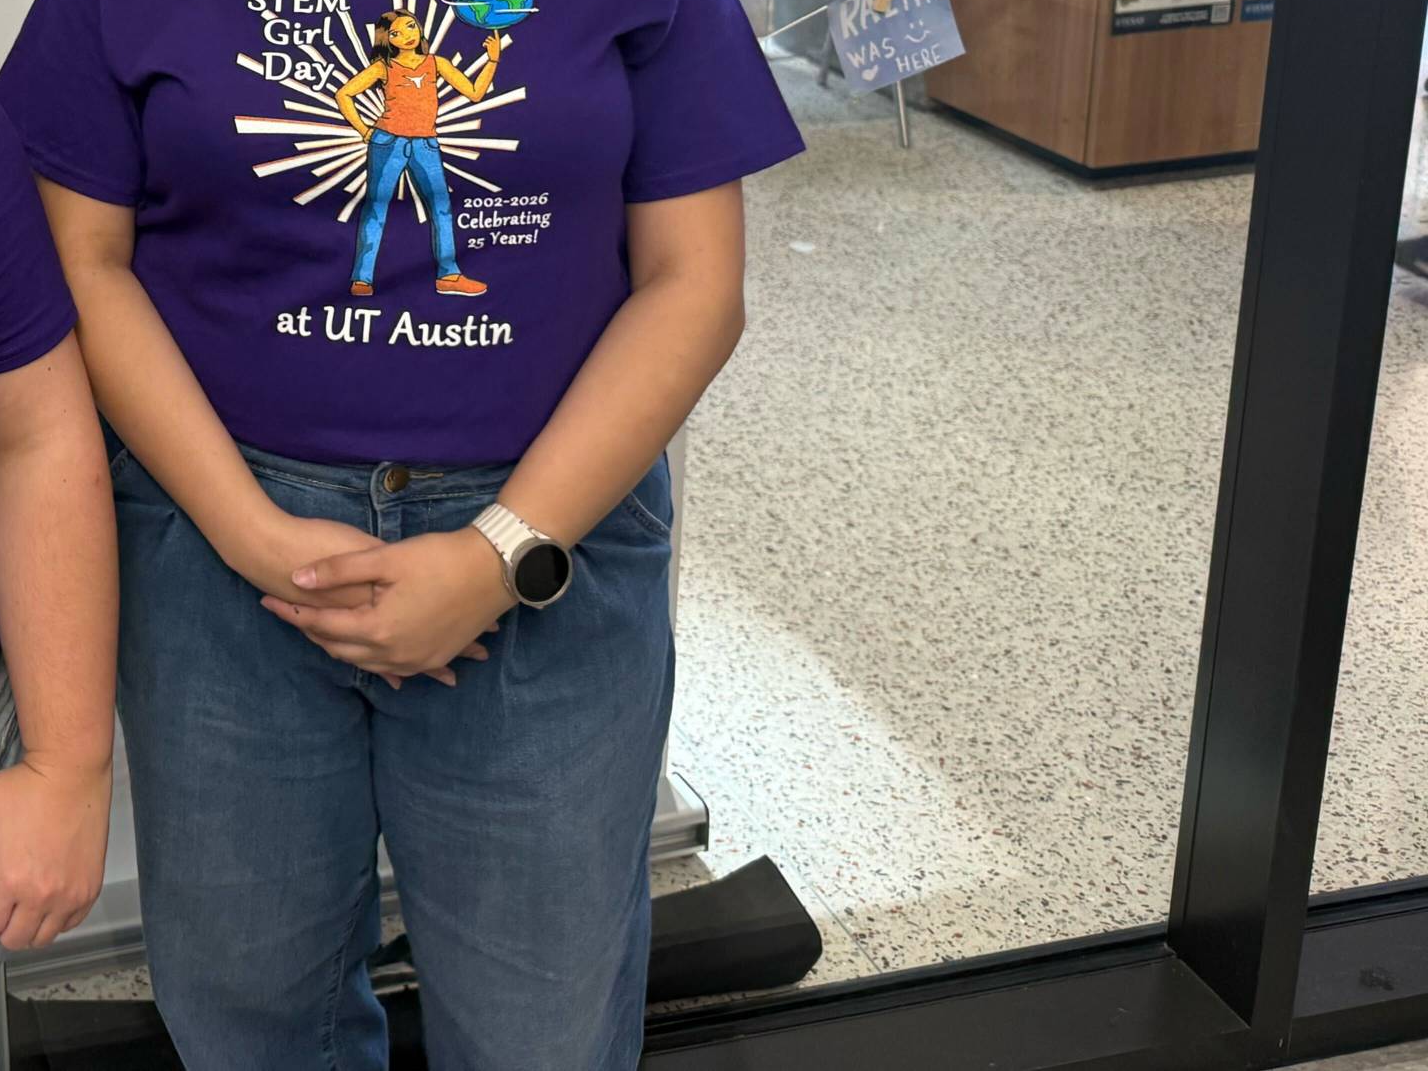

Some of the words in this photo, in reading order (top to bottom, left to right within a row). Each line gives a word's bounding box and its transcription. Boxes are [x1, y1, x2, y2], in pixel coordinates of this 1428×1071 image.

[262, 16, 335, 47] Girl
[262, 50, 336, 91] Day
[846, 37, 896, 68] WAS
[895, 43, 942, 73] HERE
[463, 192, 549, 209] 2002-2026
[457, 209, 552, 230] Celebrating
[467, 236, 485, 249] 25
[489, 229, 539, 246] Years!
[276, 306, 312, 336] at
[322, 304, 382, 343] UT
[388, 314, 514, 347] Austin
